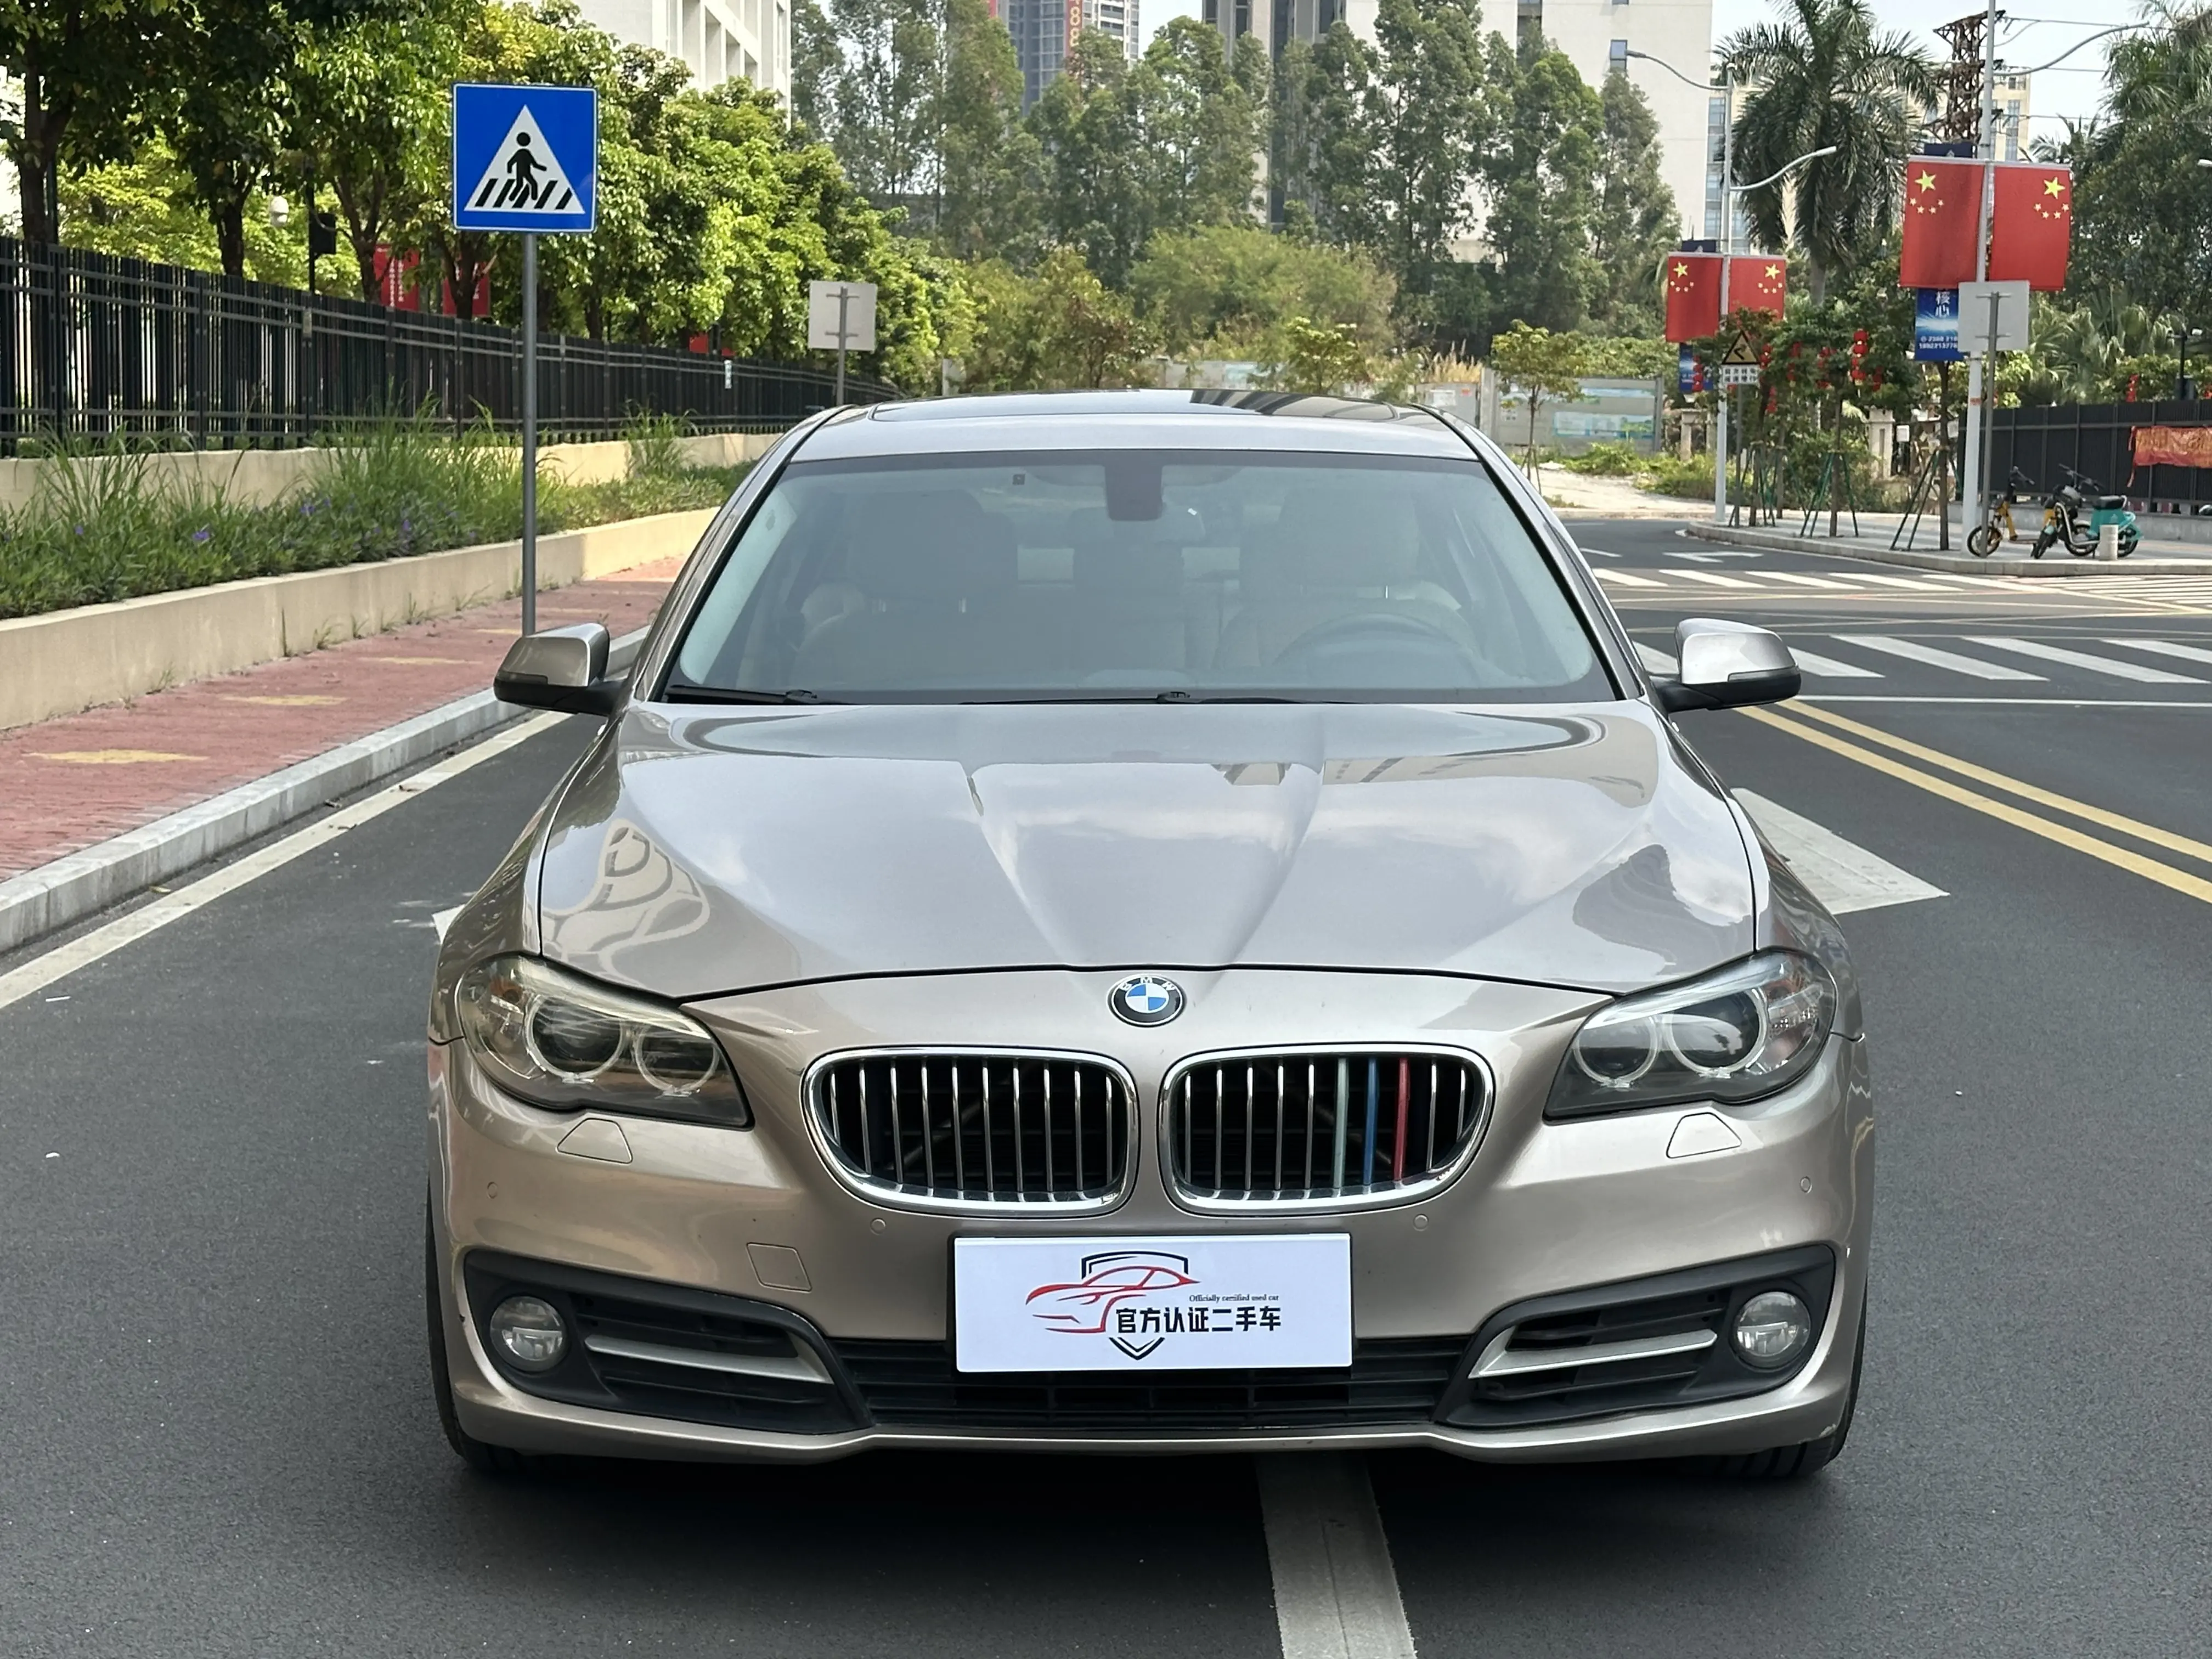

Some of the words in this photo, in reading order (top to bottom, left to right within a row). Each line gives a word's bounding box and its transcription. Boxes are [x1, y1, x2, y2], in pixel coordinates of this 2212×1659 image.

[1119, 977, 1176, 991] BMW
[1189, 1294, 1220, 1303] Officially
[1116, 1306, 1281, 1333] 官方认证二手车
